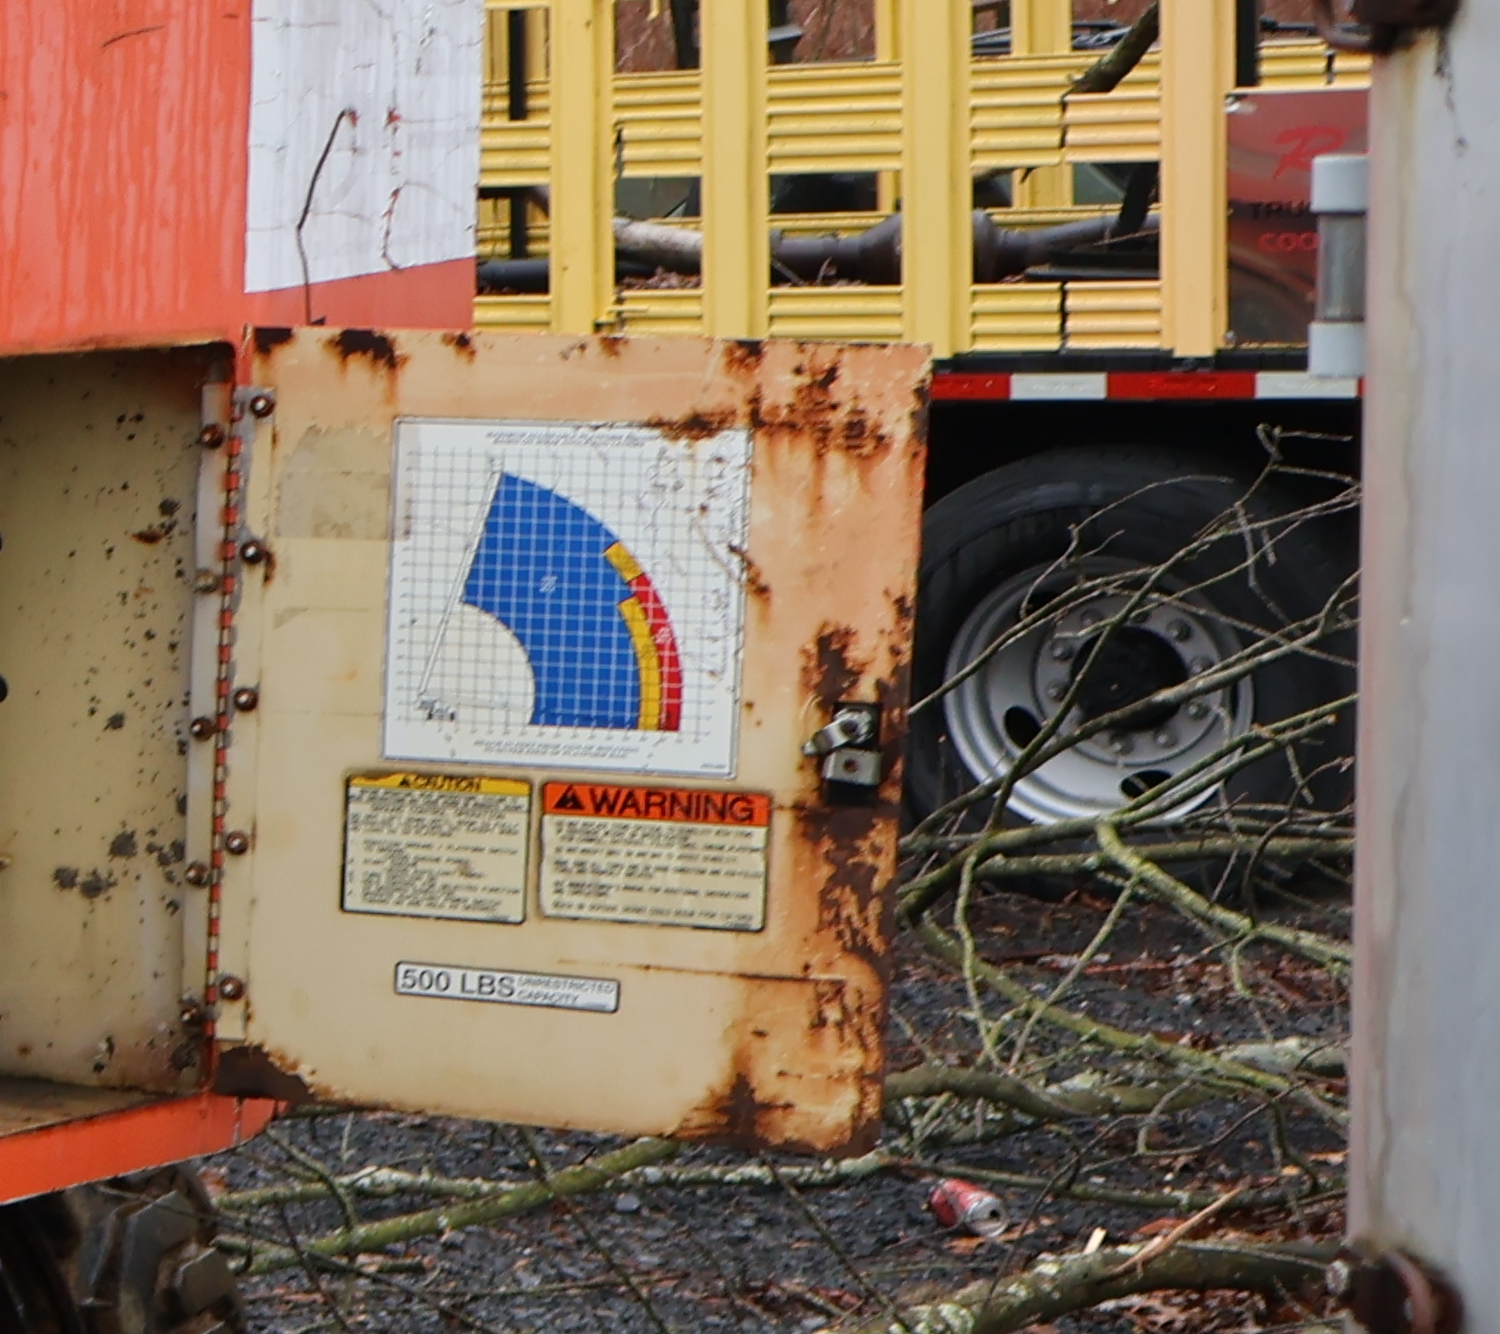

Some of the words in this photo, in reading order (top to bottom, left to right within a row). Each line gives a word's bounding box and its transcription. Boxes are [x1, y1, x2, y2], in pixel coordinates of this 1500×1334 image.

[409, 774, 481, 792] CAUTION
[589, 787, 754, 822] WARNING
[401, 968, 450, 991] 500
[461, 973, 516, 998] LBS
[517, 976, 615, 994] UNRESTRICTED
[517, 990, 579, 1005] CAPACITY
